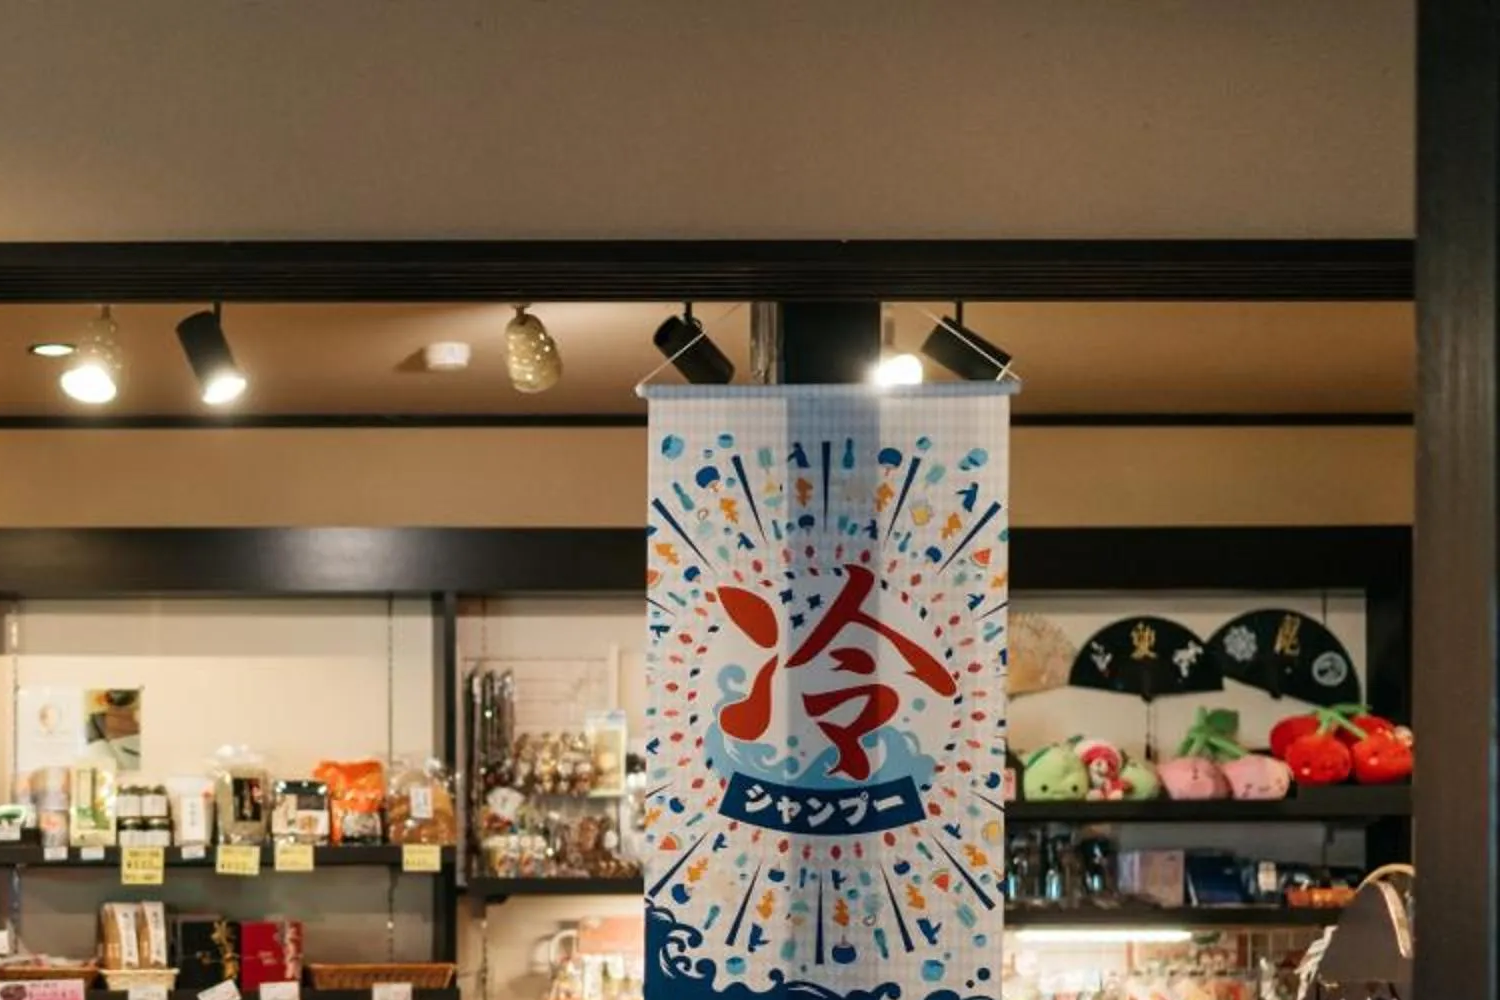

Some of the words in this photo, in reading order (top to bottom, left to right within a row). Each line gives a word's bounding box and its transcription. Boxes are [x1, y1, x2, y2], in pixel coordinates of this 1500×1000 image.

[717, 563, 958, 781] 冷
[744, 783, 904, 828] シャンプー
